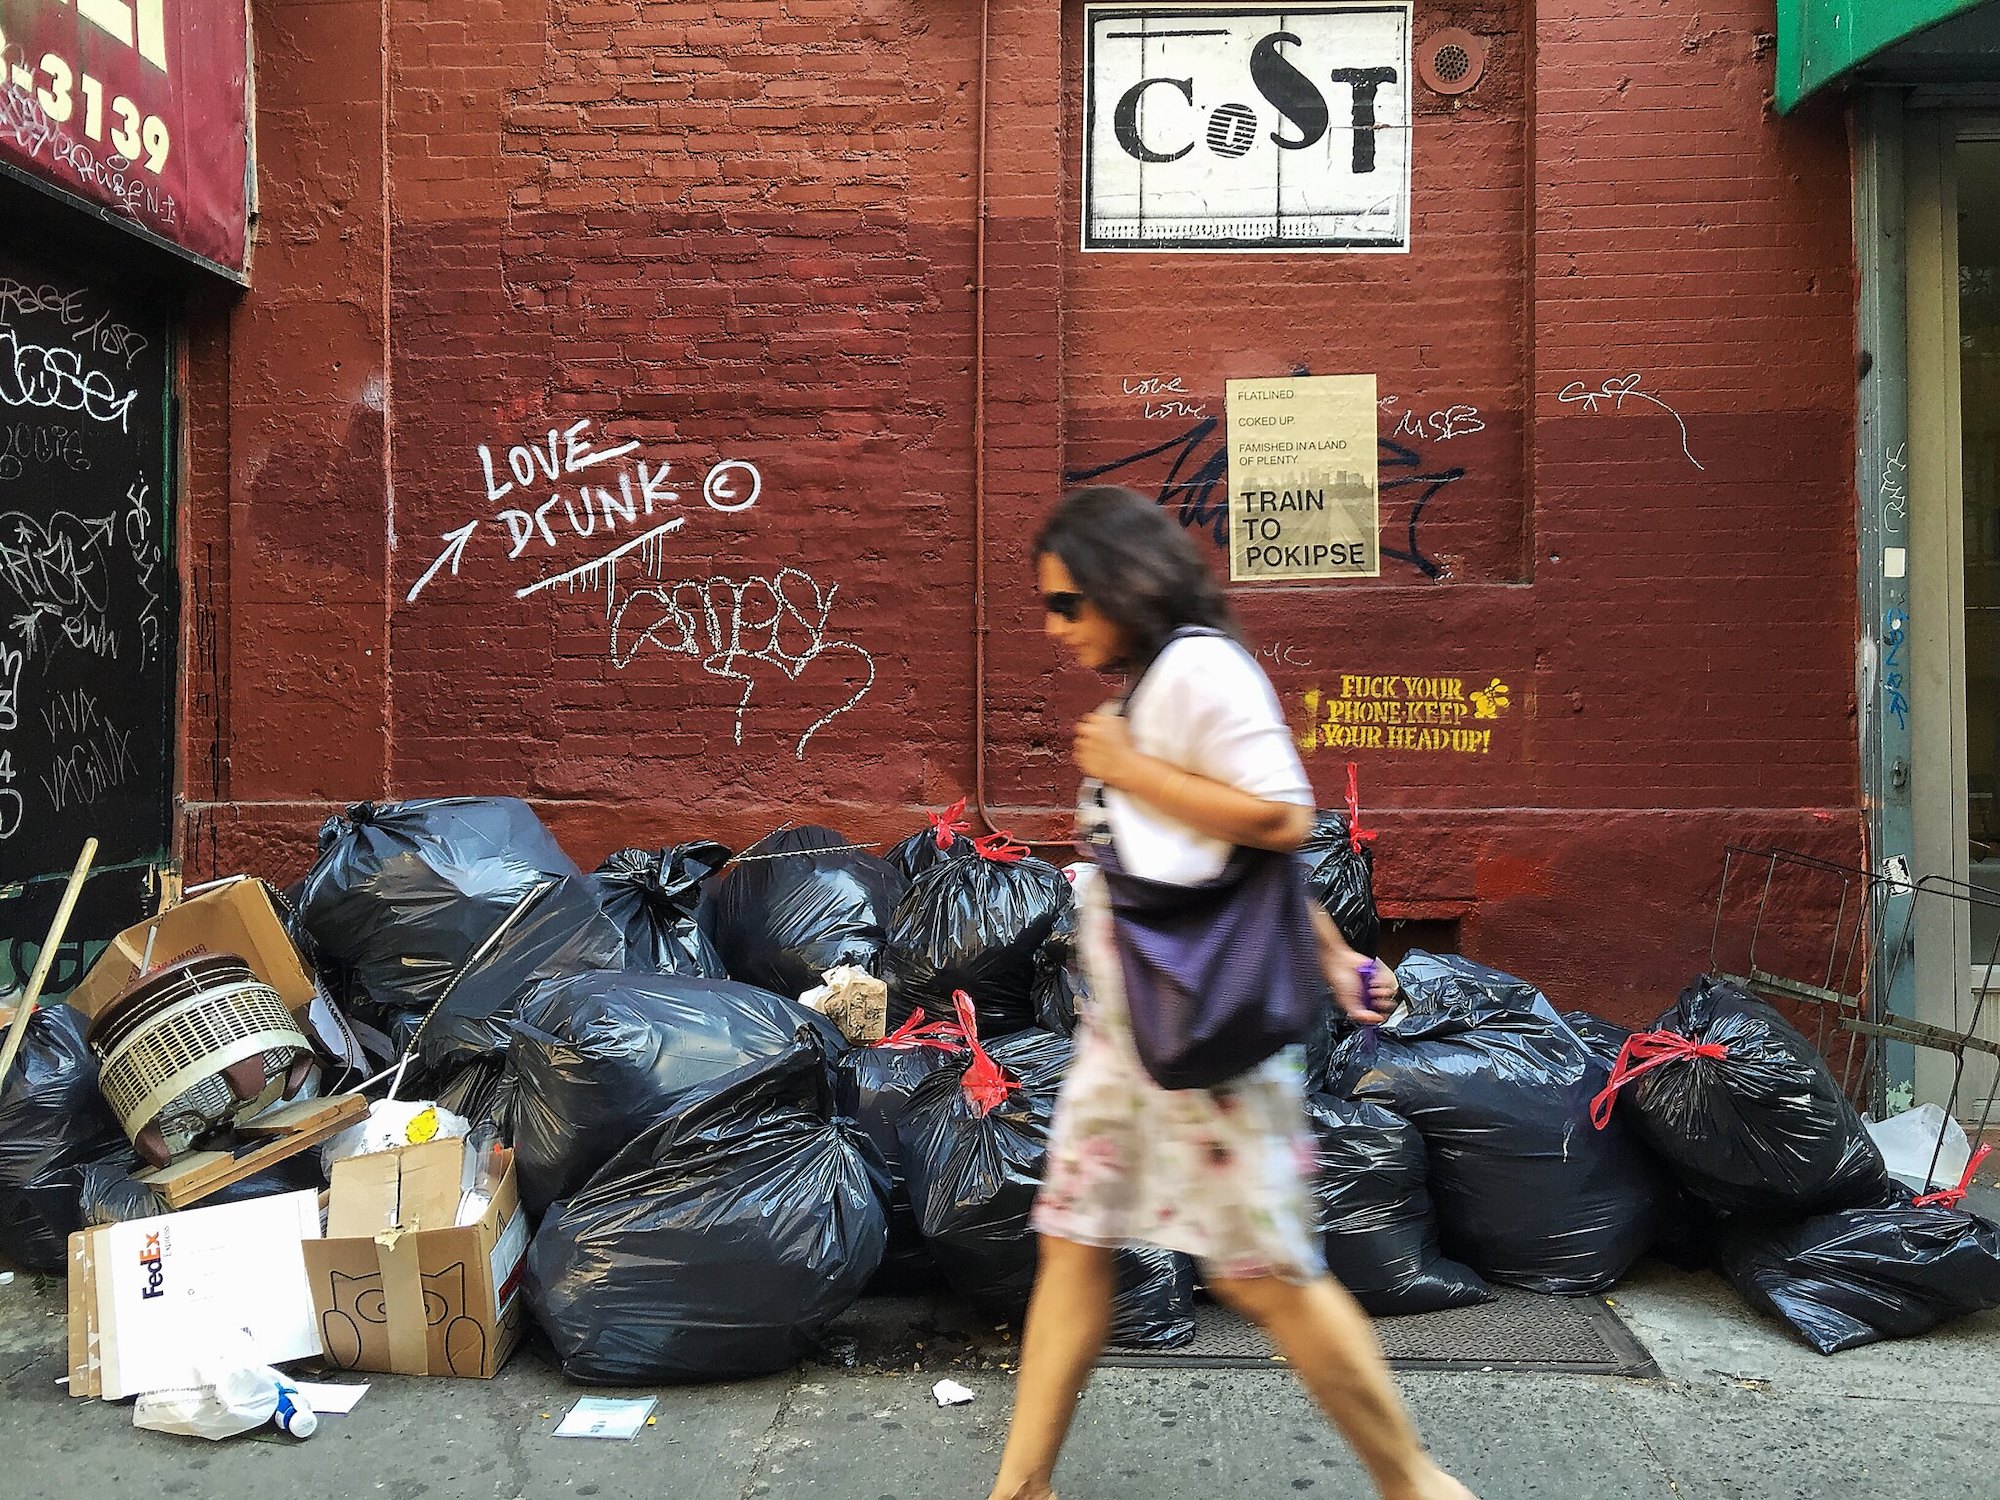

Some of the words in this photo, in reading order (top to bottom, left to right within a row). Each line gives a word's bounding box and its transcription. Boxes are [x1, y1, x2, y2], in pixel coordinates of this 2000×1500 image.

[1238, 416, 1276, 427] COKED
[1238, 441, 1294, 453] FAMISHED
[1296, 441, 1307, 451] IN
[1308, 441, 1318, 450] A
[1318, 440, 1347, 451] LAND
[477, 418, 641, 502] LOVE
[1239, 456, 1255, 466] OF
[1240, 489, 1325, 513] TRAIN
[1242, 517, 1281, 541] TO
[1246, 543, 1366, 568] POKIPSE
[1339, 674, 1401, 699] FUCK
[1401, 676, 1465, 702] YOUR
[1320, 723, 1385, 749] YOUR
[1386, 725, 1450, 751] HEAD
[1450, 728, 1492, 754] UP!
[139, 1230, 164, 1300] FedEx
